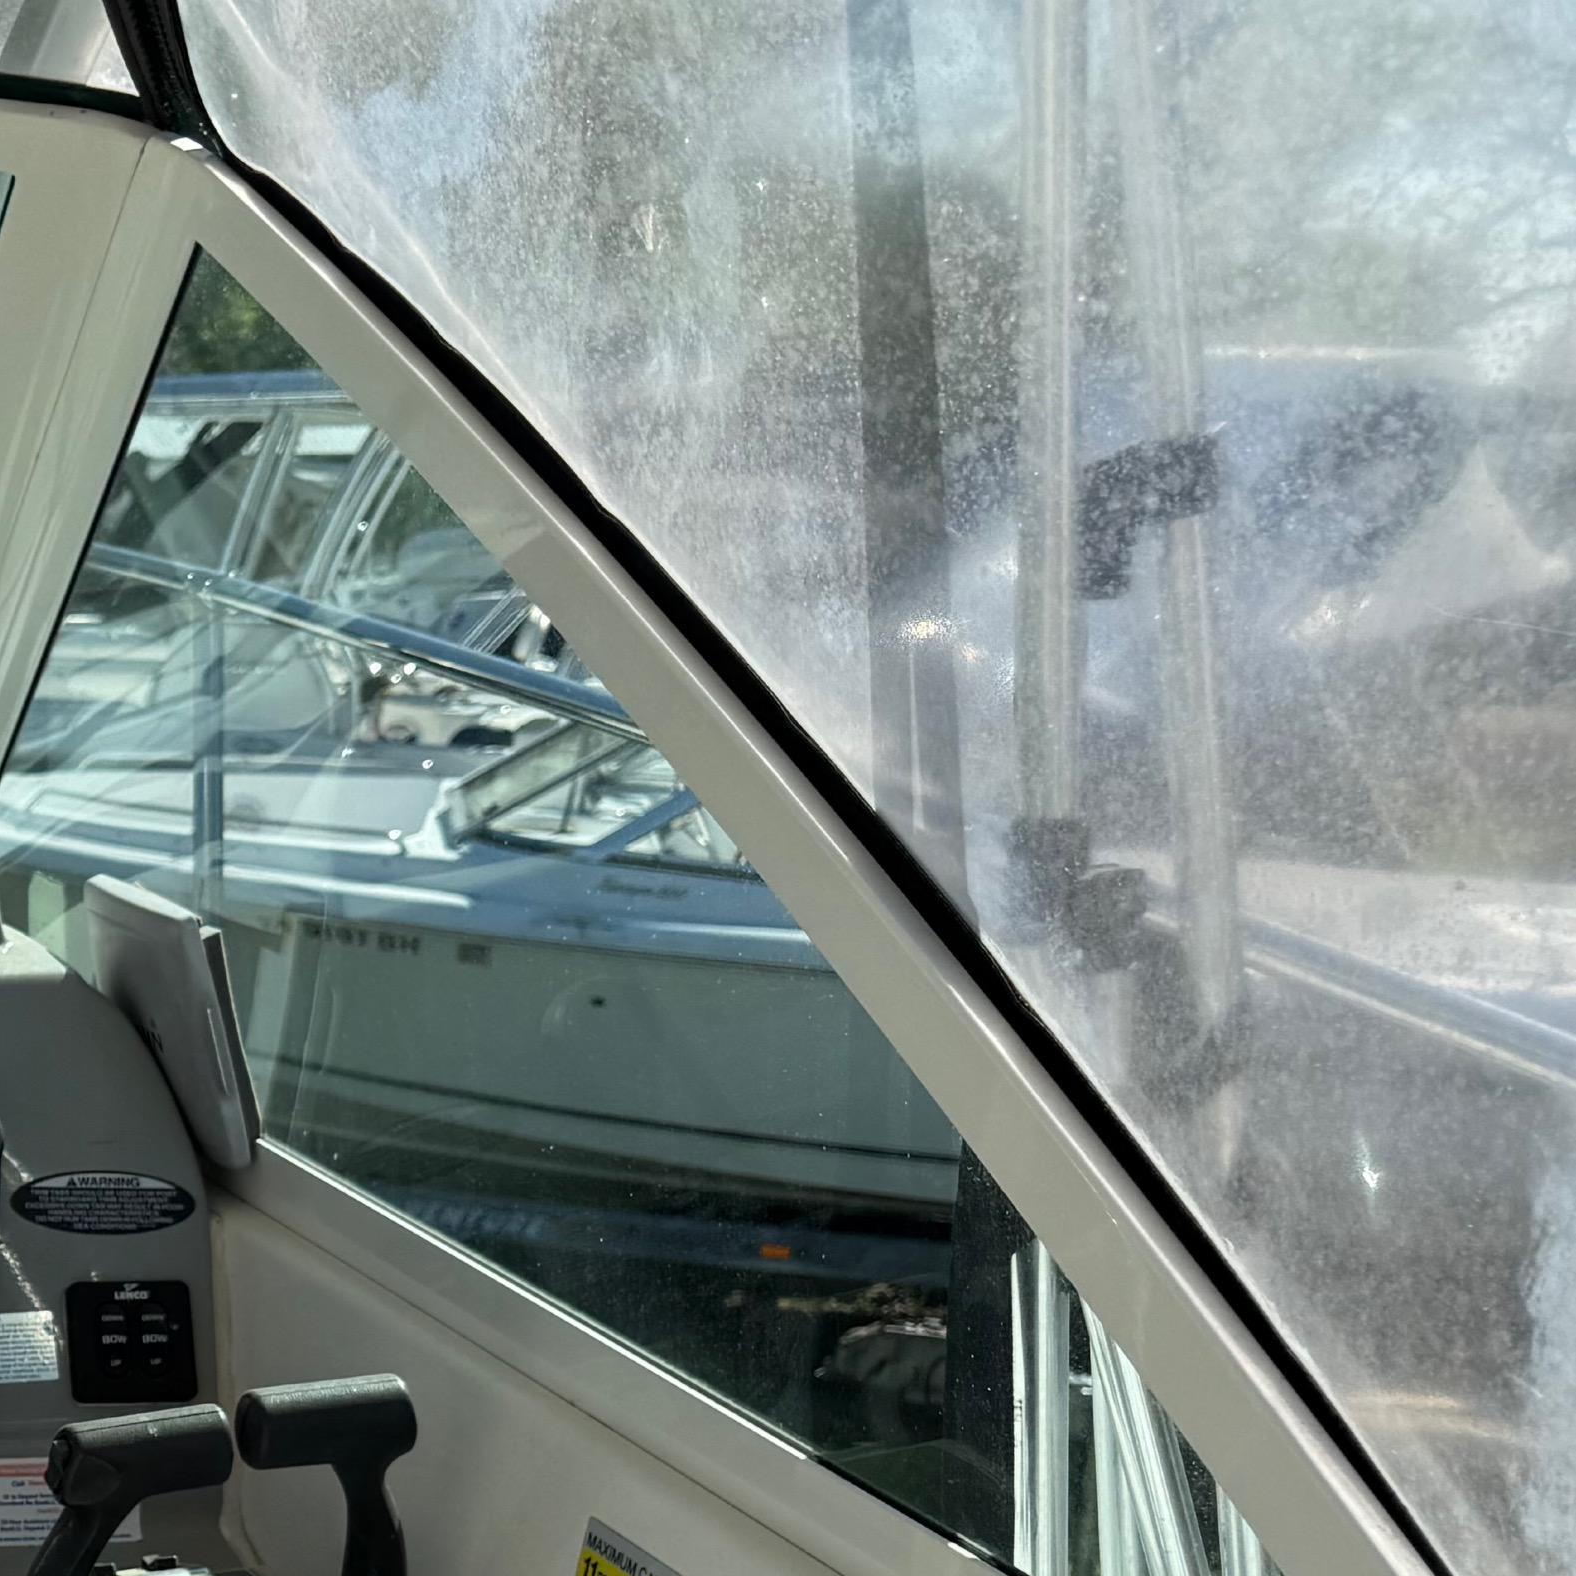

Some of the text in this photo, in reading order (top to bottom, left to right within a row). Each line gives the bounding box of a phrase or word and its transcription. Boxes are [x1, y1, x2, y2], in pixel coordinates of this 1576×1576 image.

[78, 1177, 140, 1187] WARNING
[114, 1290, 150, 1300] LENCO
[102, 1335, 127, 1344] BOW
[142, 1334, 169, 1344] BOW
[587, 1532, 637, 1576] MAXIMUM
